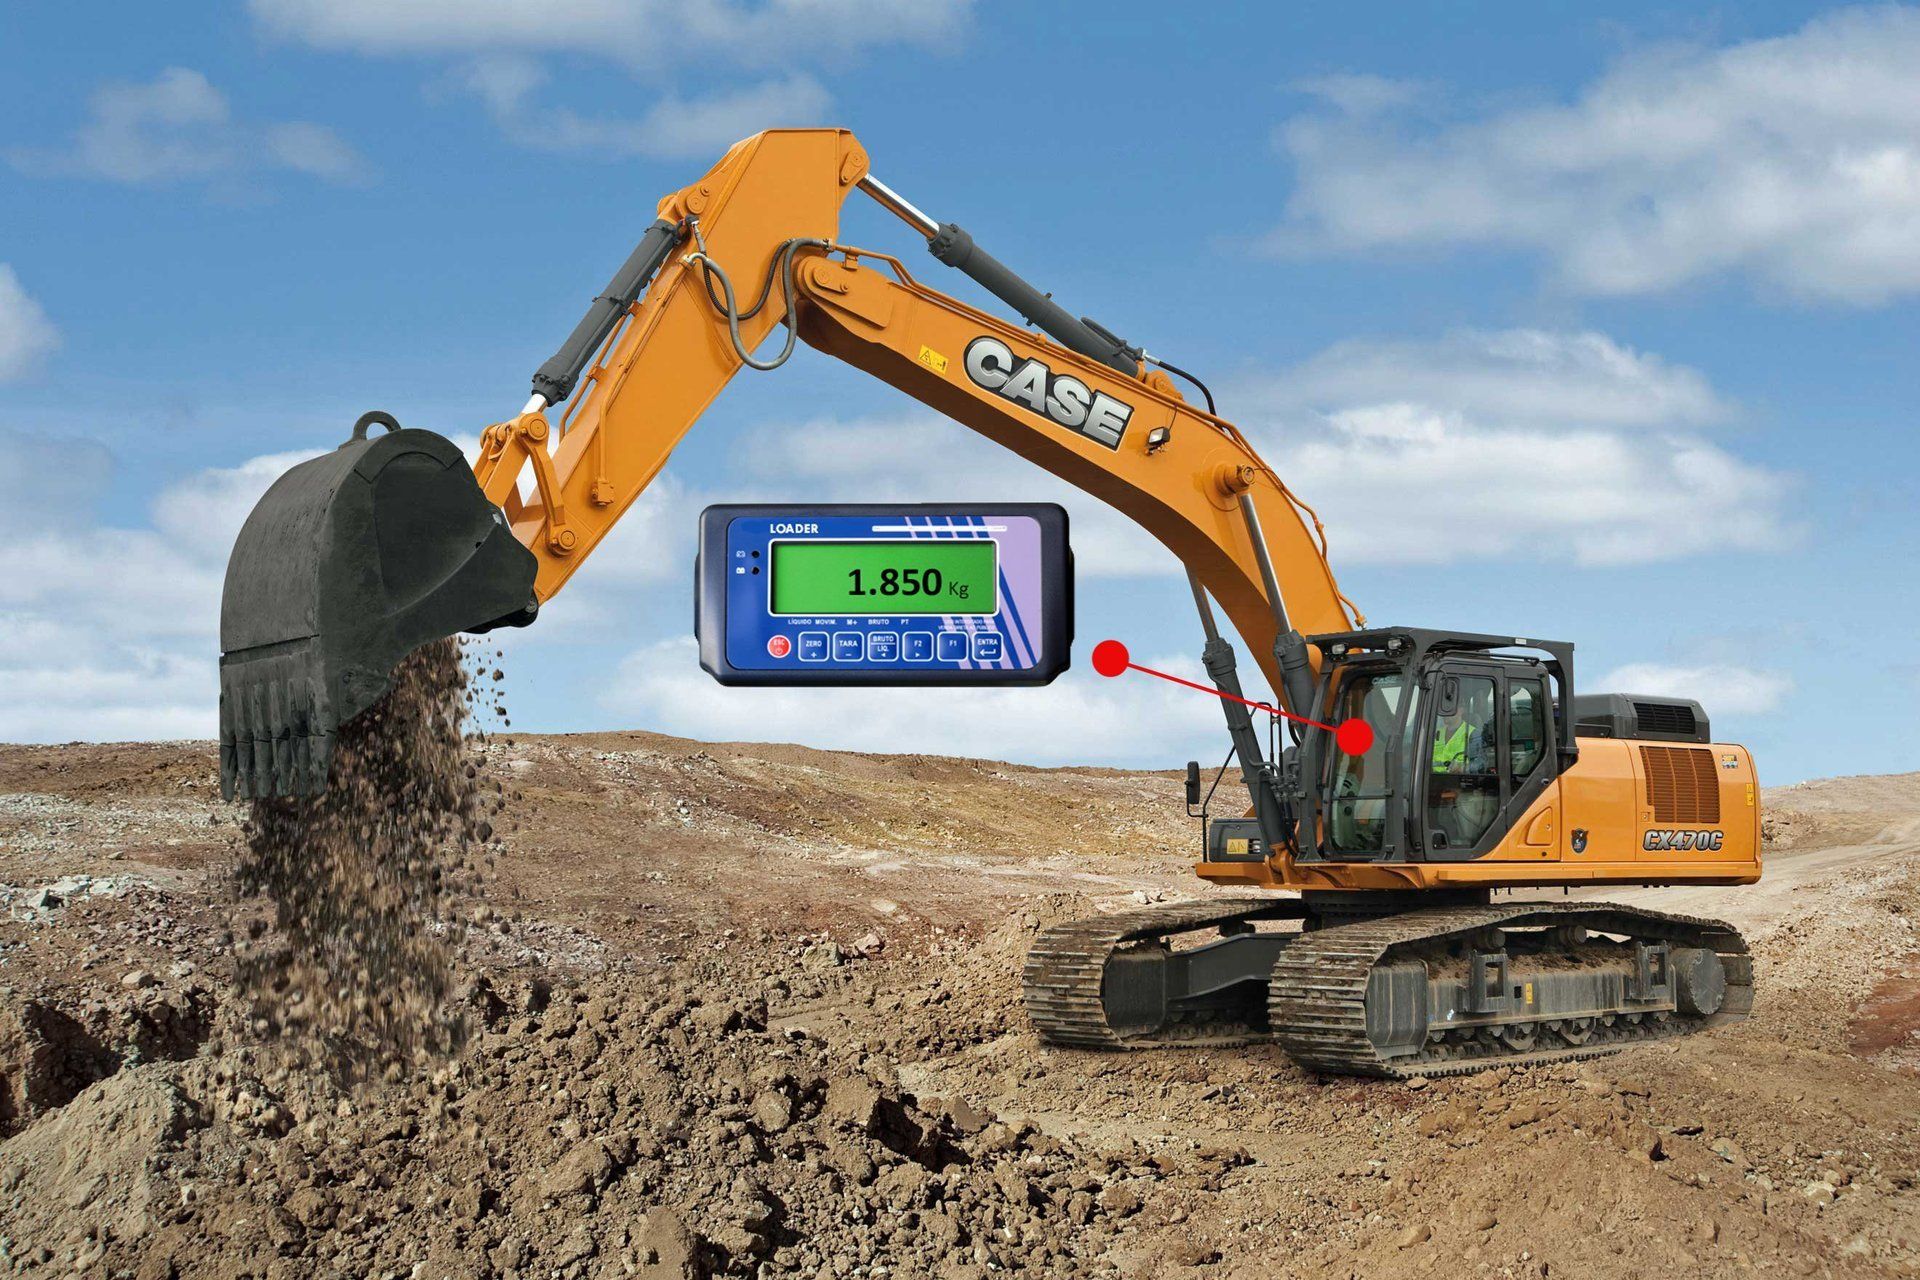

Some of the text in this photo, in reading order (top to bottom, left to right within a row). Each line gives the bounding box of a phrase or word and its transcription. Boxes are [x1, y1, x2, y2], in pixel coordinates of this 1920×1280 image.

[965, 337, 1133, 448] CASE
[770, 523, 819, 534] LOADER
[848, 568, 969, 599] 1.850 Kg
[1643, 829, 1724, 851] CX470C
